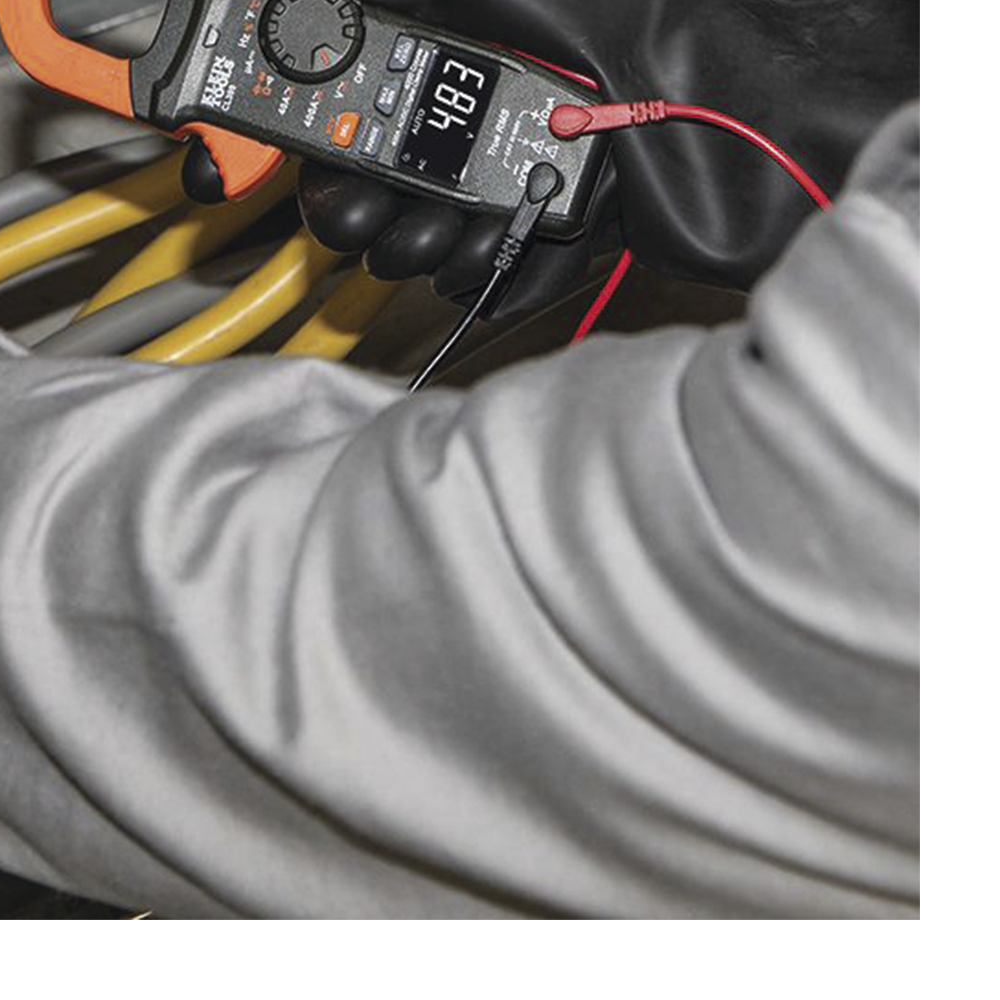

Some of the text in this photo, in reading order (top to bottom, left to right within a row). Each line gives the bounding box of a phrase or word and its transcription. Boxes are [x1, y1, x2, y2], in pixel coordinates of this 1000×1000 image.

[200, 56, 227, 107] KLEIN
[211, 58, 235, 107] TOOLS
[354, 63, 367, 84] OFF
[427, 59, 485, 130] 483
[365, 126, 379, 153] RANGE
[411, 108, 426, 135] AUTO
[486, 108, 510, 157] True RMS
